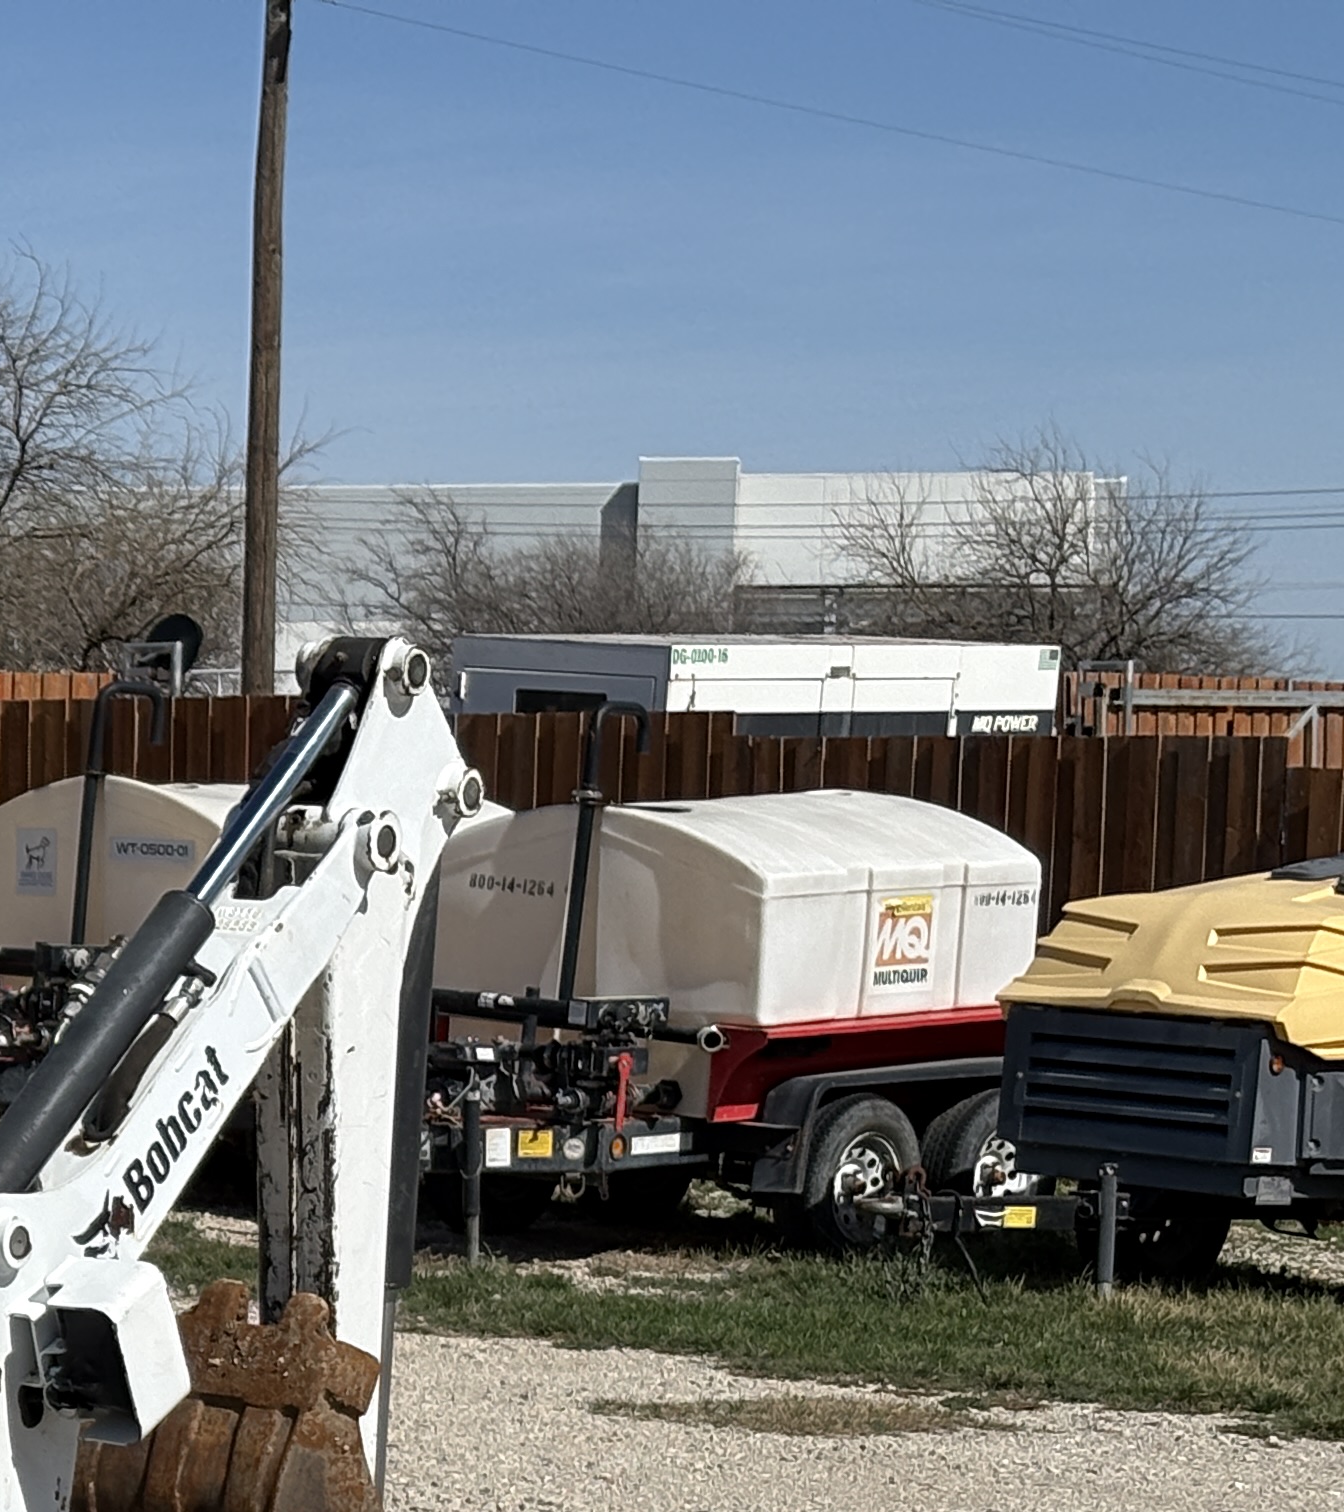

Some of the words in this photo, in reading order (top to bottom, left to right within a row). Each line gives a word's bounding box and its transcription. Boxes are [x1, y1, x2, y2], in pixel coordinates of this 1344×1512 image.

[993, 715, 1038, 732] POWER
[115, 841, 189, 857] WT-0500-01
[469, 873, 555, 897] 800-14-1264
[122, 1045, 230, 1216] Bobcat
